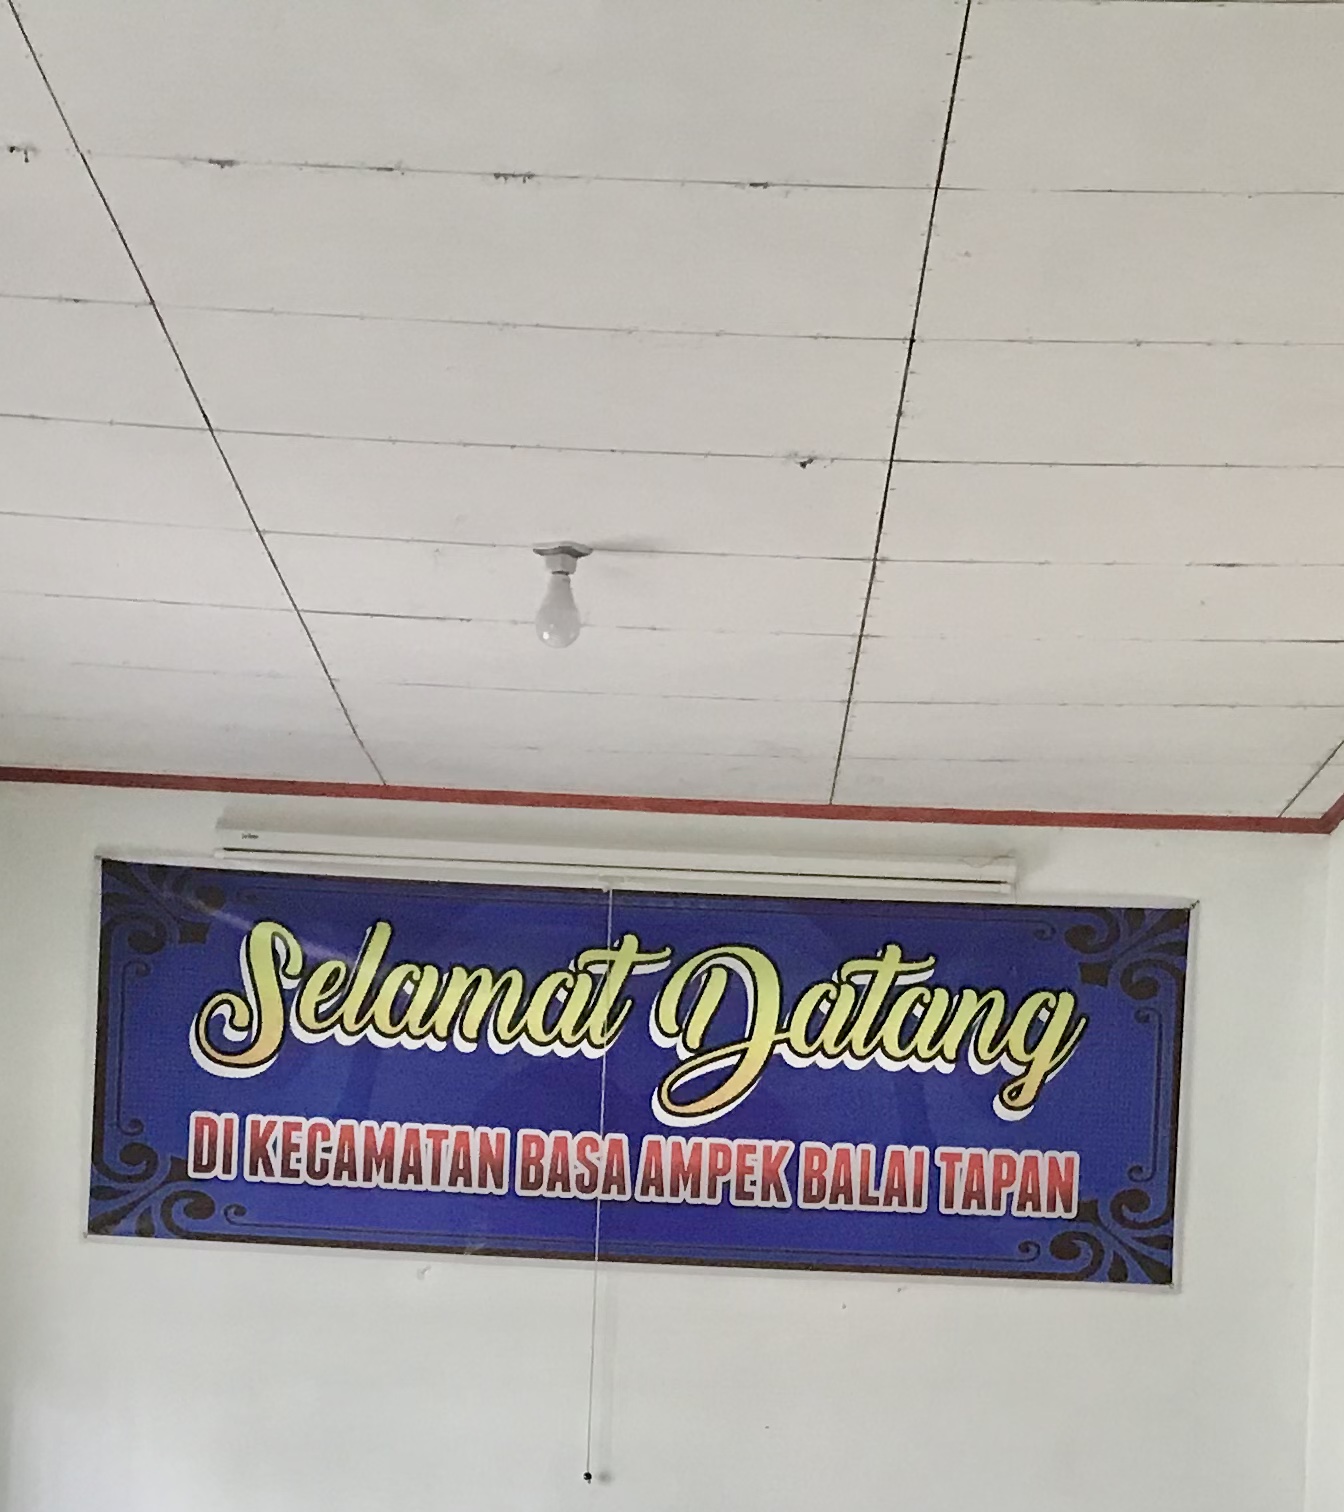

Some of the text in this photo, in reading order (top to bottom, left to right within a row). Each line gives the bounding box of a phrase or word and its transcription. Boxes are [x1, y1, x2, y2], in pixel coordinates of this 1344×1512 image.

[190, 919, 1087, 1127] Selamat Datang
[189, 1113, 1080, 1218] DI KECAMATAN BASA AMPEK BALAI TAPAN
